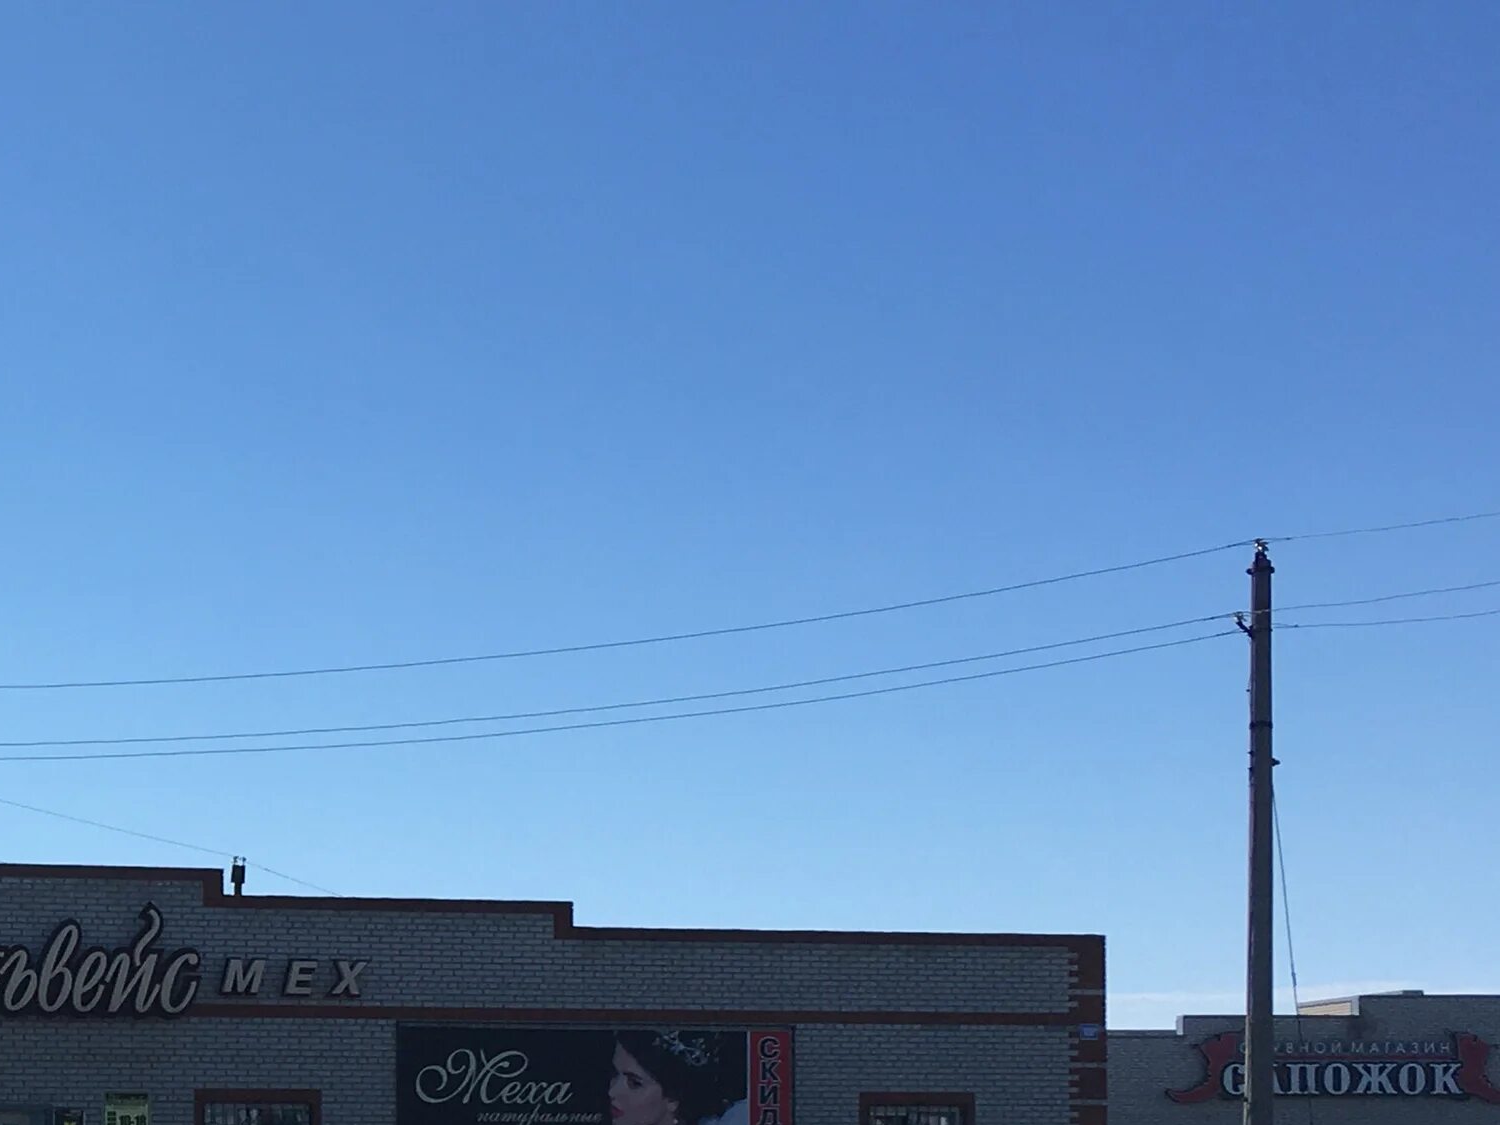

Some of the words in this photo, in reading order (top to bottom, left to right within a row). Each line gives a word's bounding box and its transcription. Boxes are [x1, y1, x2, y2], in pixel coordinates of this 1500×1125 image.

[221, 957, 369, 997] МЕХ
[1351, 1041, 1451, 1055] МАГАЗИН
[415, 1047, 573, 1105] Меха
